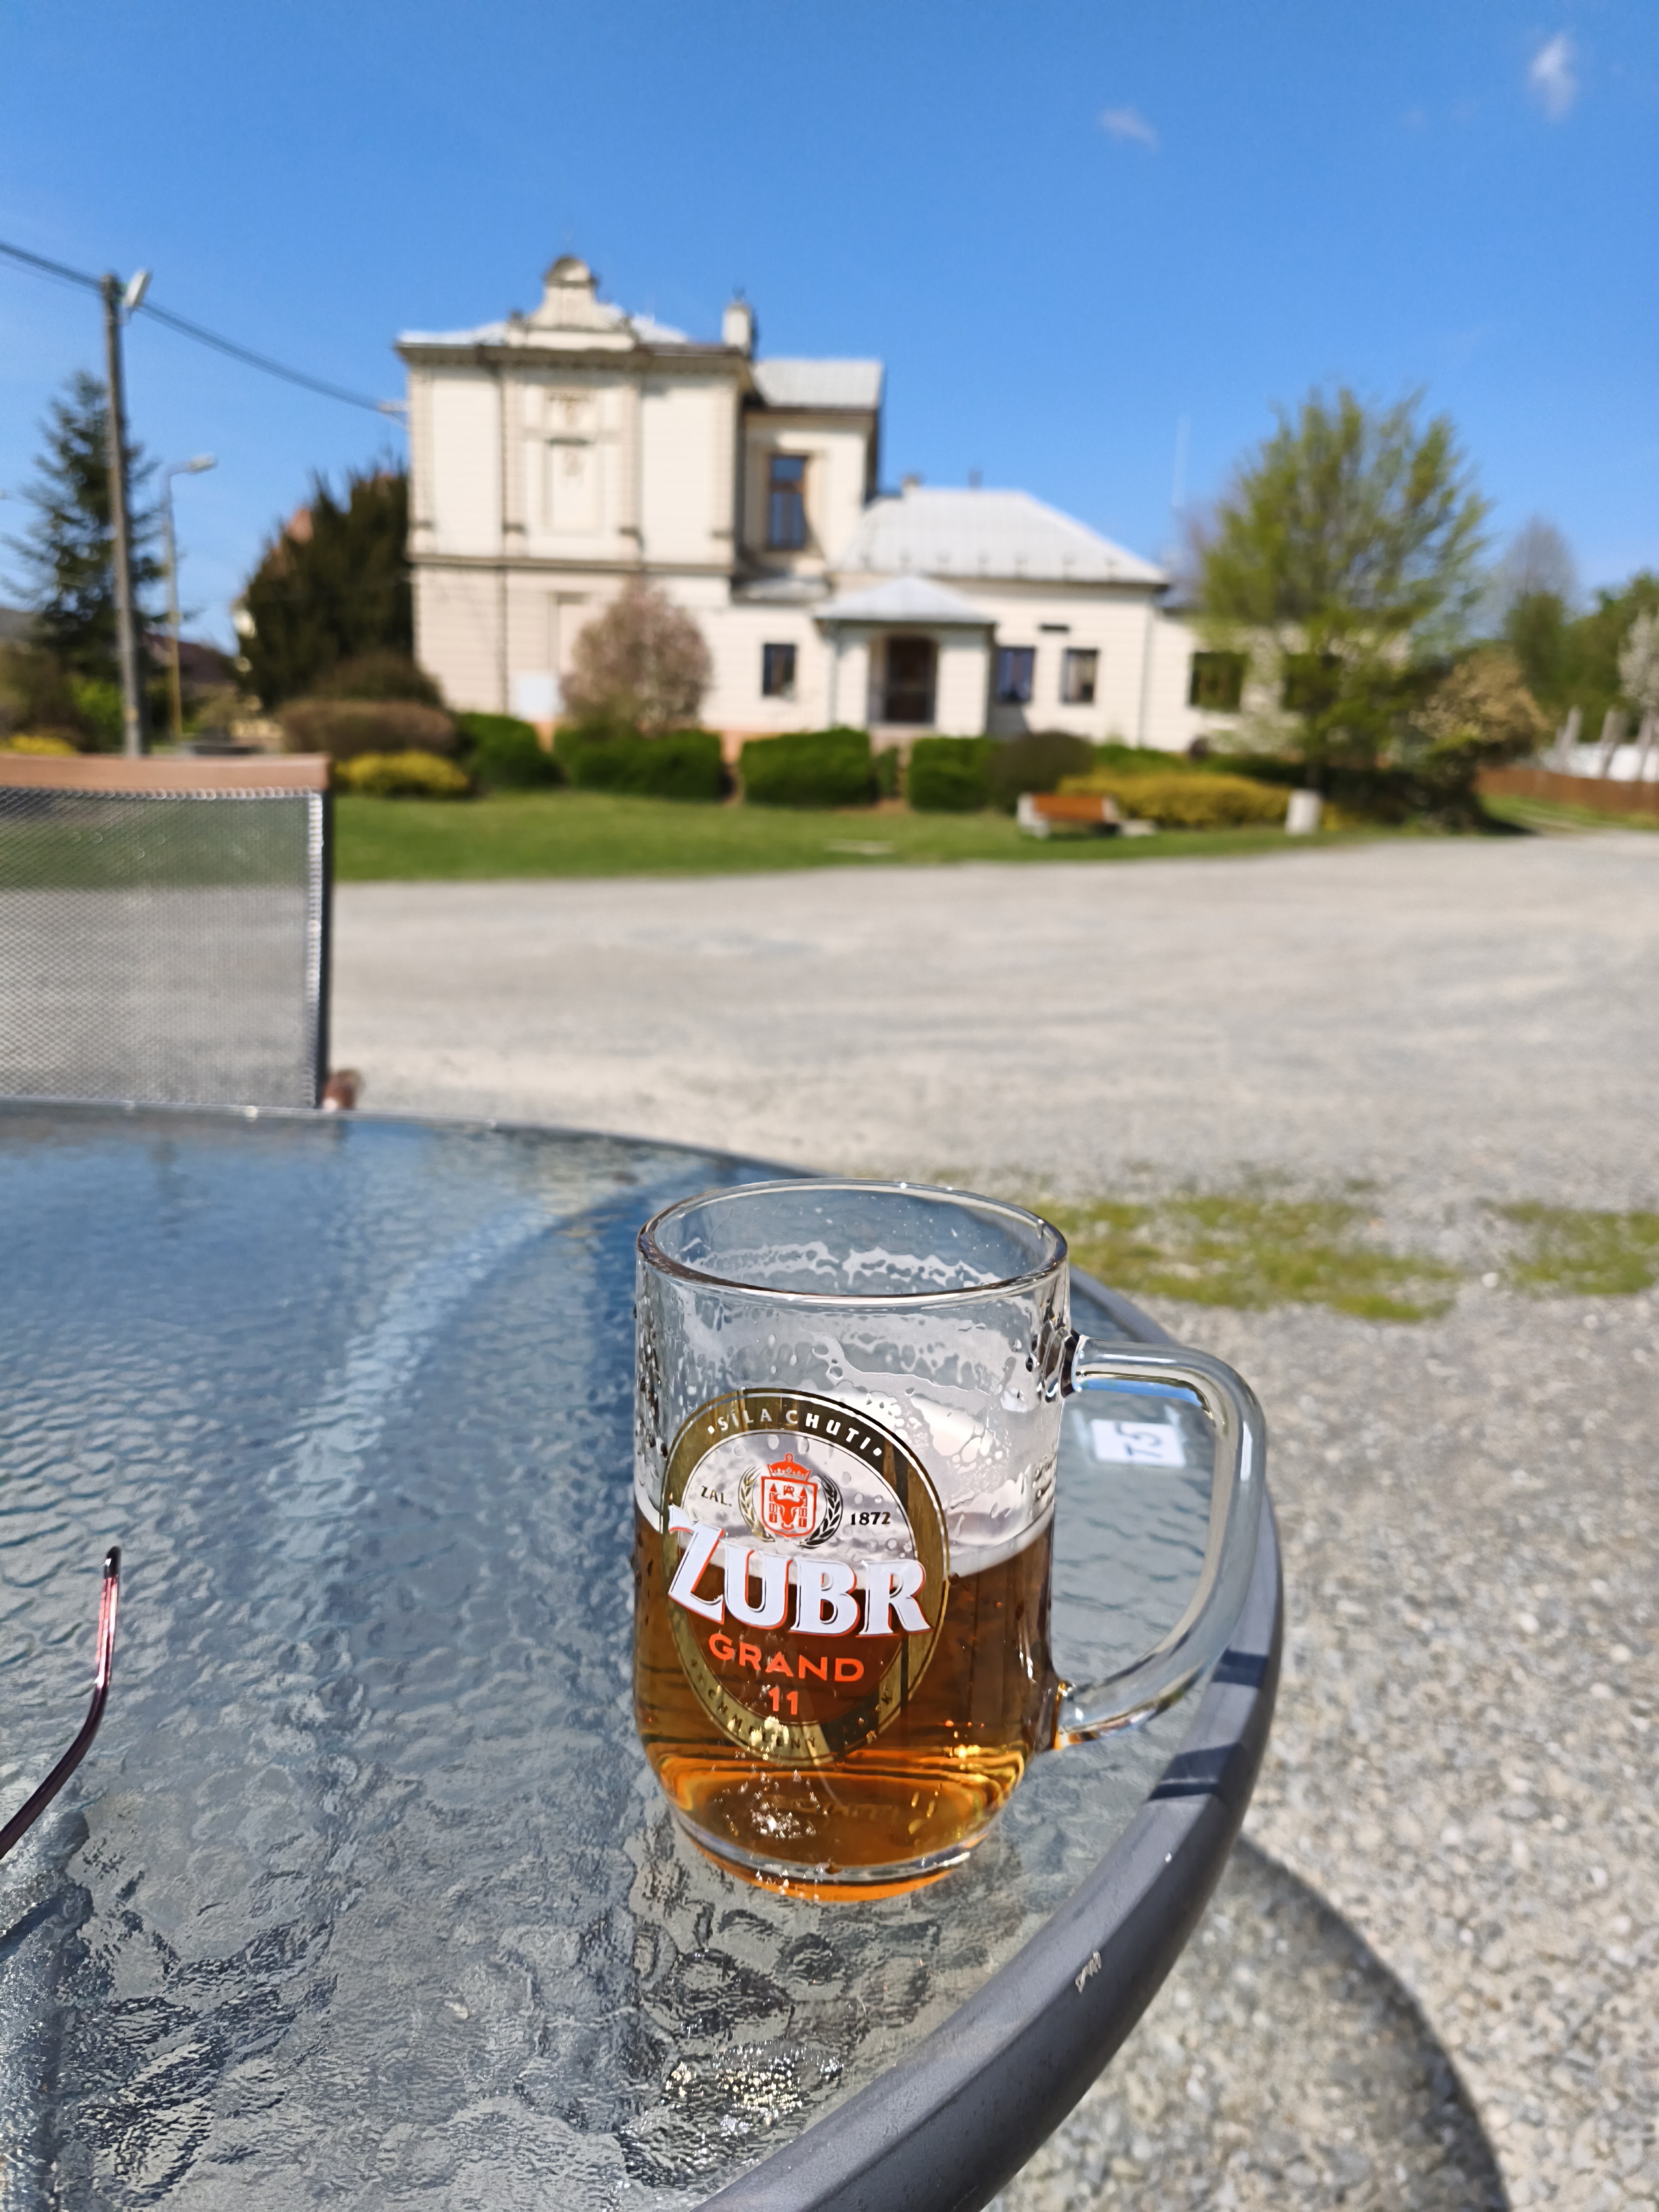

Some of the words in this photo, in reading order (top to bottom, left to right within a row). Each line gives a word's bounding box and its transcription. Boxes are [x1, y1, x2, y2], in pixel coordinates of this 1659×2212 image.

[717, 1408, 772, 1431] SÍLA
[785, 1410, 871, 1449] CHUTI
[701, 1485, 732, 1507] ZAL.
[851, 1511, 891, 1526] 1872
[668, 1504, 935, 1638] ZUBR
[709, 1633, 865, 1682] GRAND
[768, 1687, 798, 1715] 11
